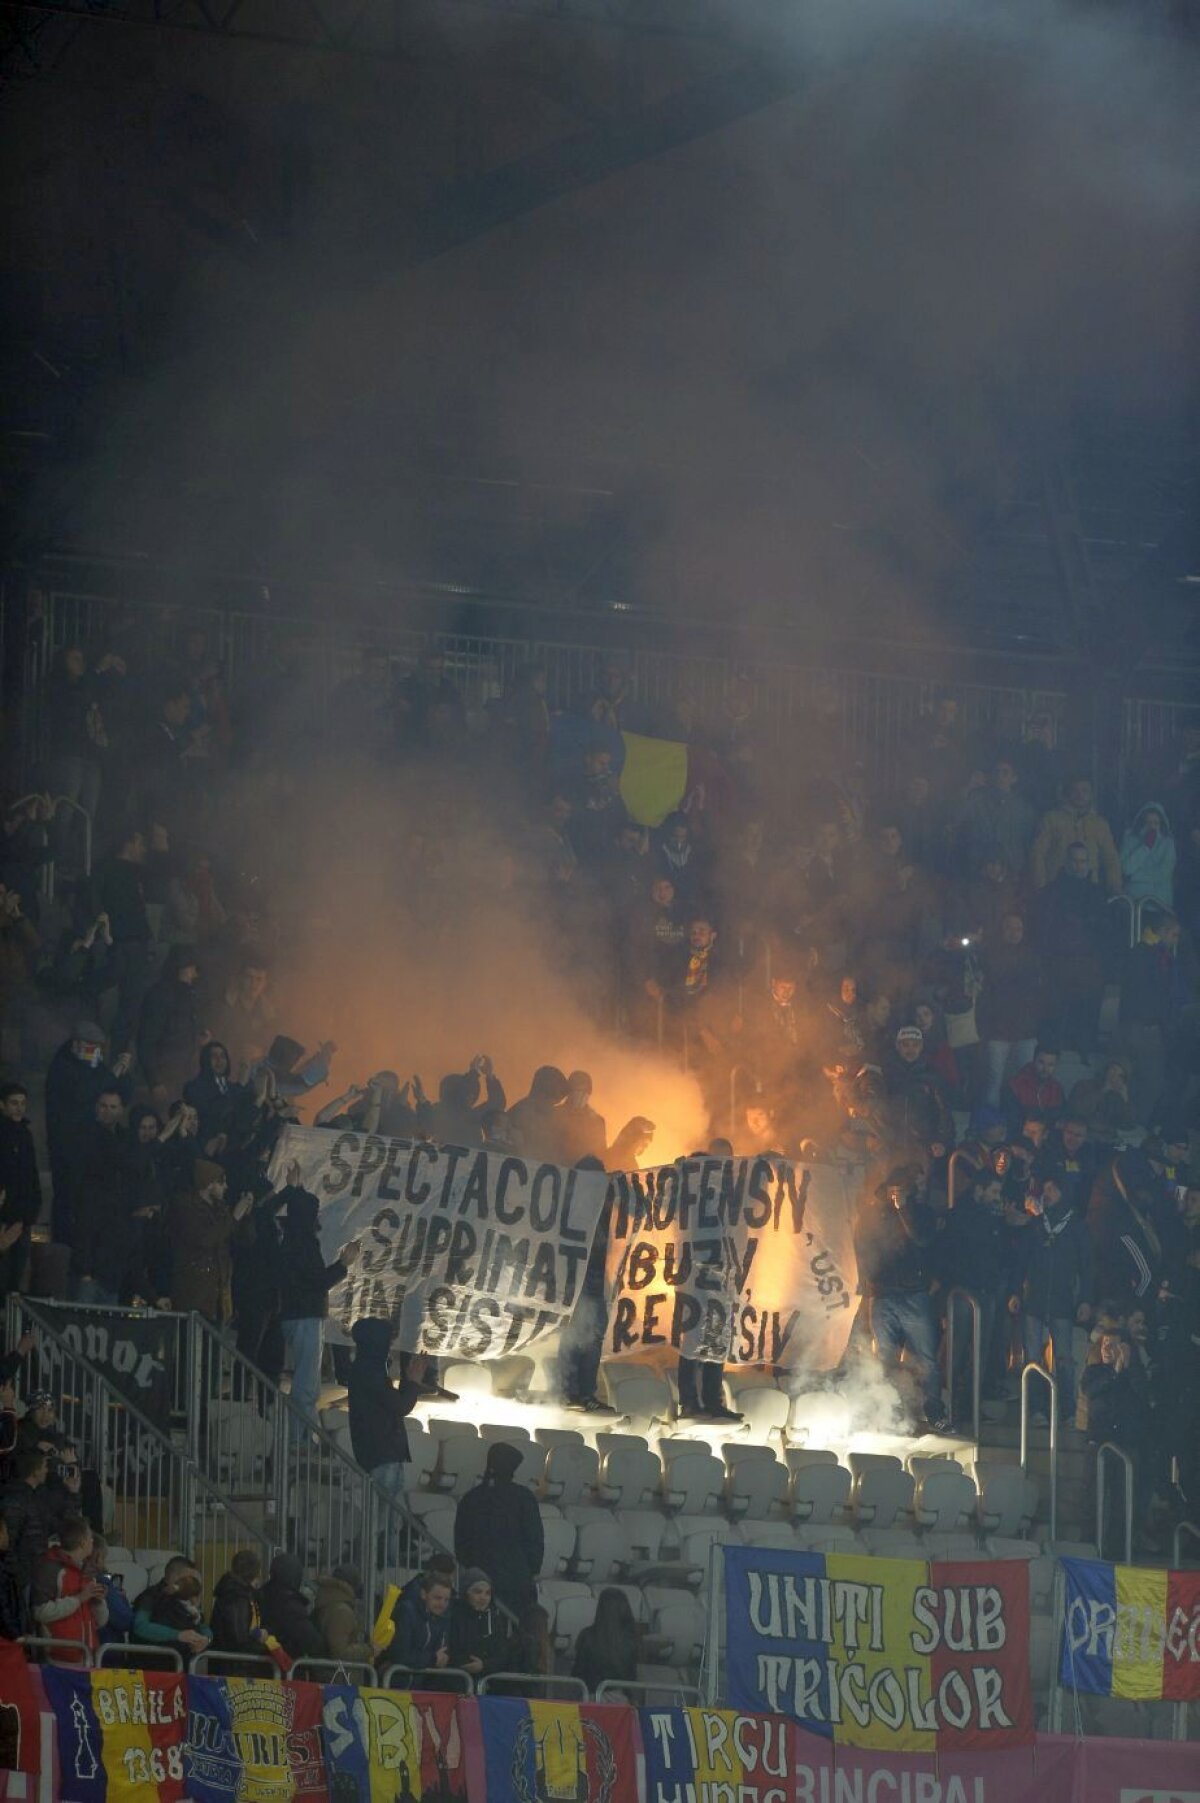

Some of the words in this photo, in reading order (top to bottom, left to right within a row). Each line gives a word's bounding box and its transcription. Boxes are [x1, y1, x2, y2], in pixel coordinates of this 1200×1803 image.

[322, 1132, 587, 1242] SPECTACOL
[362, 1207, 588, 1306] SUPRIMAT
[910, 1585, 1006, 1654] SUB
[757, 1654, 1013, 1731] TRICOLOR
[123, 1745, 184, 1783] 1368
